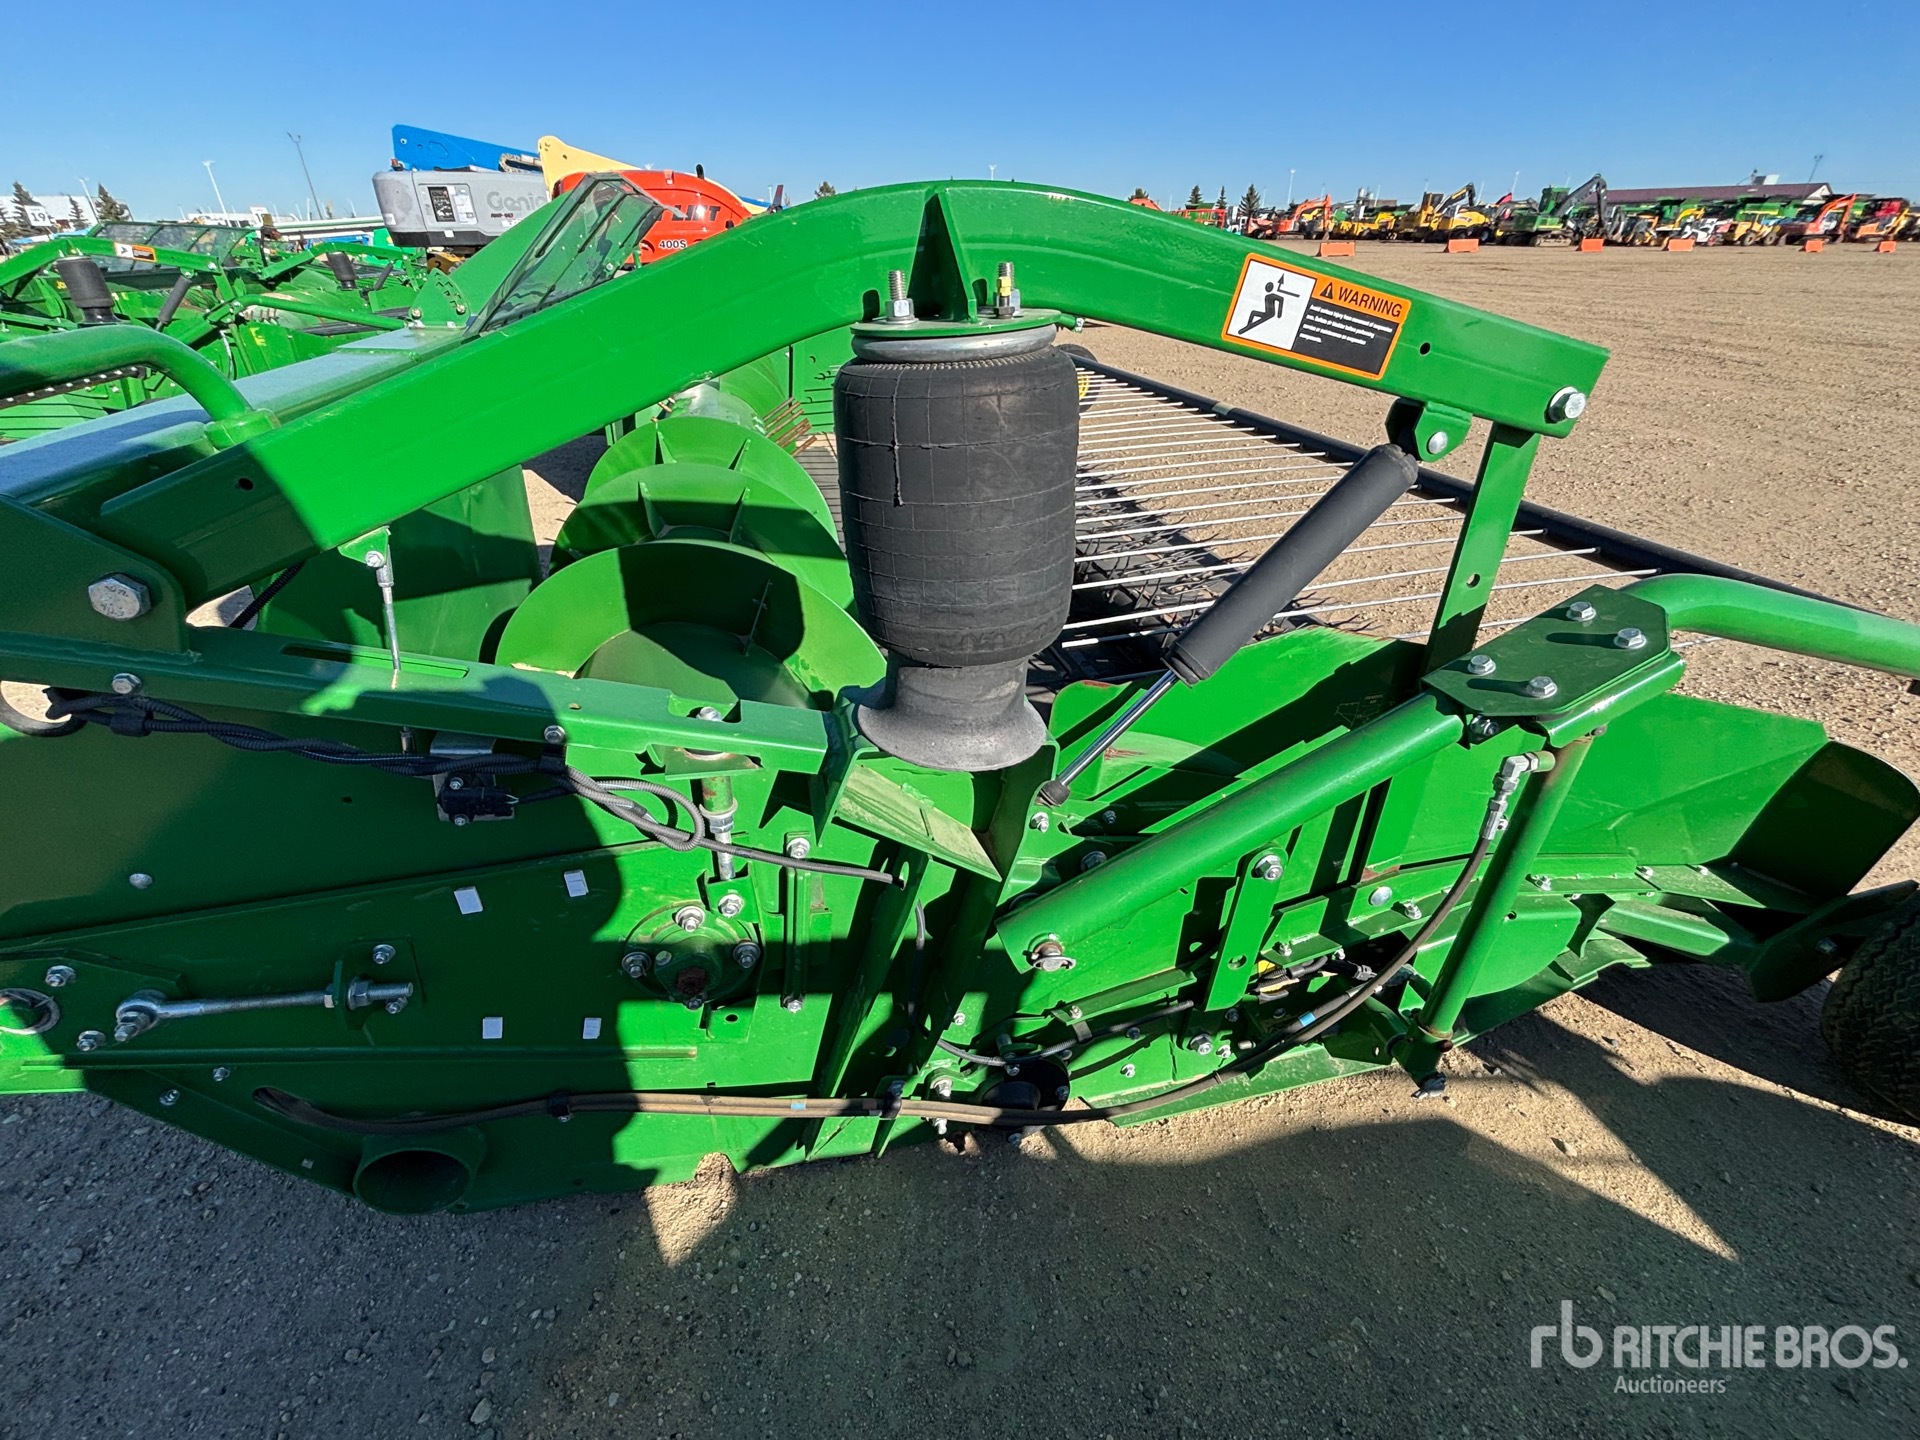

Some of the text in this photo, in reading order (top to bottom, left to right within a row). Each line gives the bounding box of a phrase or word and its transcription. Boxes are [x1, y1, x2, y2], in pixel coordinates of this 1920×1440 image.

[31, 212, 46, 222] 19
[659, 240, 687, 249] 400S
[1338, 286, 1403, 317] WARNING
